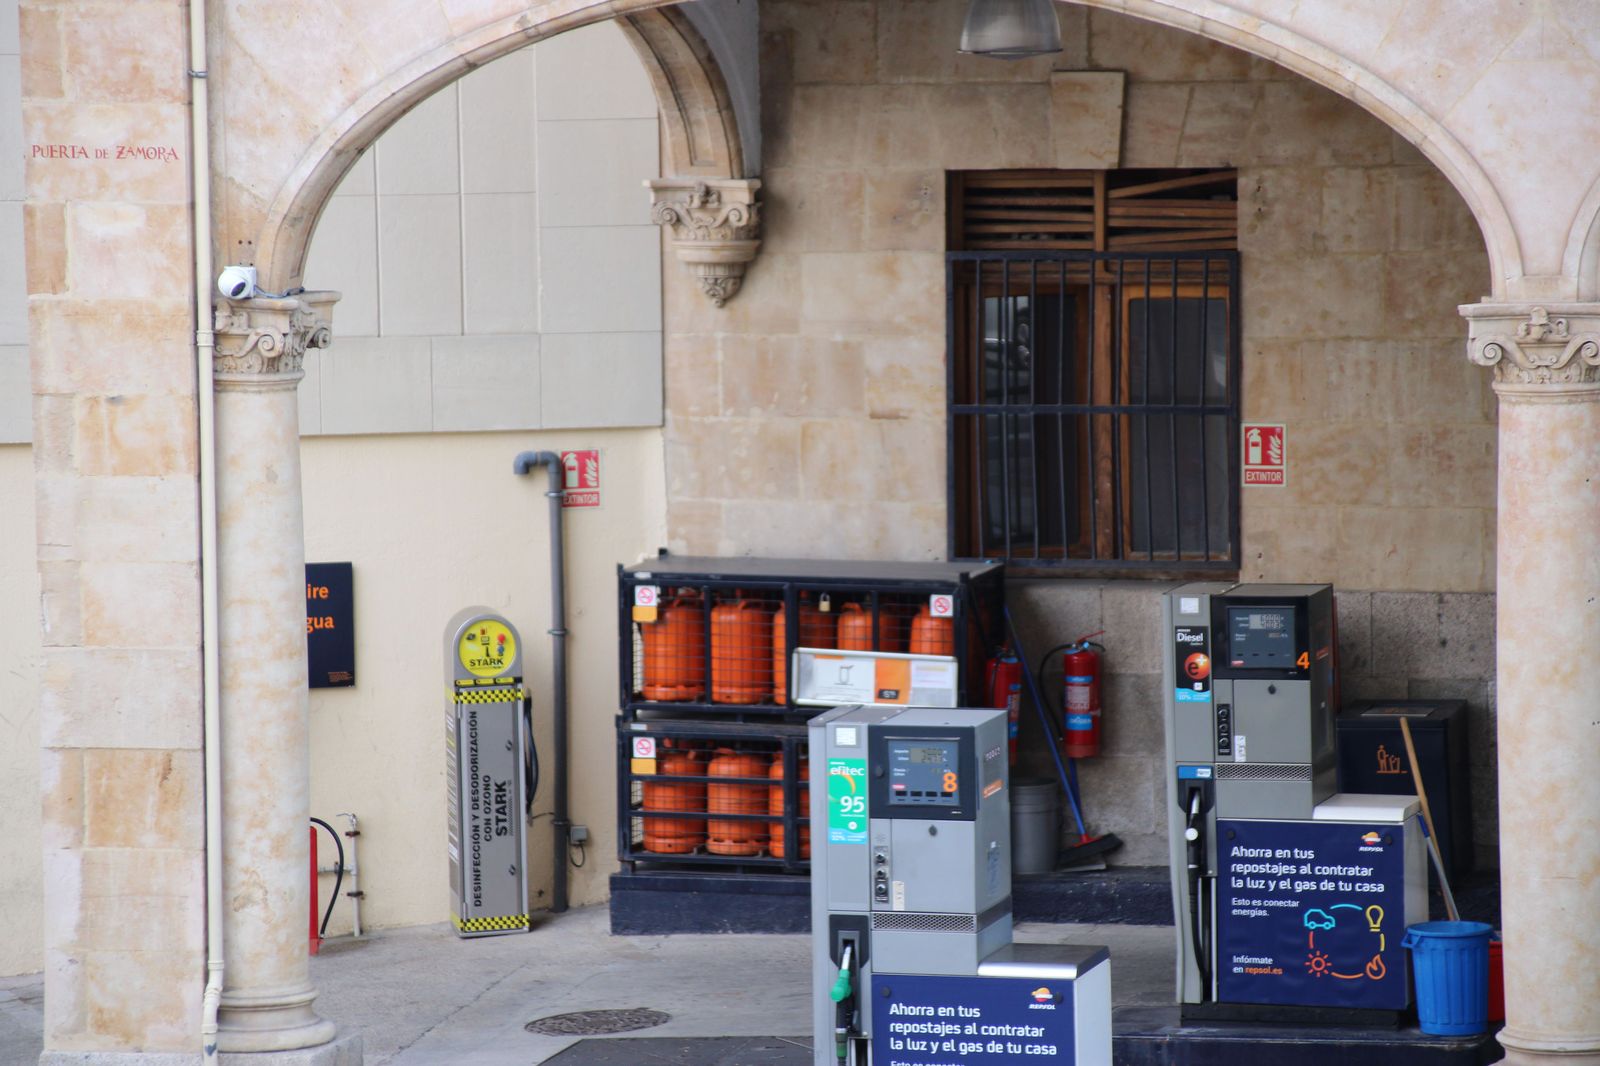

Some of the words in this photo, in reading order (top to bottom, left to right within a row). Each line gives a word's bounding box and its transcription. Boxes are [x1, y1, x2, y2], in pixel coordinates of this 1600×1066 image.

[32, 144, 89, 159] PUERTA
[95, 149, 109, 159] DE
[116, 145, 179, 163] ZAMORA
[1246, 471, 1282, 481] EXTINTOR
[307, 584, 329, 599] ire
[306, 616, 335, 633] gua
[1177, 633, 1204, 642] Diesel
[470, 658, 504, 667] STARK
[1296, 651, 1310, 670] 4
[468, 711, 480, 810] DESODORIZACIÓN
[830, 766, 865, 776] efitec
[943, 772, 958, 792] 8
[482, 775, 492, 814] OZONO
[494, 780, 508, 836] STARK
[840, 796, 865, 813] 95
[483, 819, 492, 842] CON
[1231, 846, 1273, 858] Ahorra
[1275, 849, 1291, 858] en
[1294, 848, 1315, 859] tus
[471, 825, 482, 907] DESINFECCIÓN
[1231, 862, 1297, 876] repostajes
[1300, 863, 1312, 875] al
[1315, 865, 1373, 876] contratar
[1231, 877, 1244, 888] la
[1246, 877, 1266, 889] luz
[1268, 879, 1277, 891] y
[1279, 878, 1291, 890] el
[1294, 880, 1317, 892] gas
[1320, 880, 1336, 891] de
[1338, 881, 1352, 891] tu
[1355, 882, 1385, 892] casa
[1232, 897, 1251, 906] Esto
[1263, 899, 1300, 907] conectar
[1232, 908, 1270, 918] energías.
[1233, 955, 1273, 965] Infórmate
[1245, 966, 1283, 975] repsol.es
[889, 1003, 935, 1016] Ahorra
[938, 1006, 955, 1017] en
[958, 1005, 981, 1017] tus
[889, 1022, 961, 1036] repostajes
[964, 1022, 978, 1035] al
[981, 1025, 1045, 1037] contratar
[890, 1037, 903, 1050] la
[907, 1038, 928, 1051] luz
[930, 1041, 940, 1054] y
[942, 1039, 956, 1052] el
[959, 1041, 984, 1055] gas
[986, 1040, 1003, 1053] de
[1007, 1042, 1022, 1054] tu
[1025, 1044, 1057, 1055] casa
